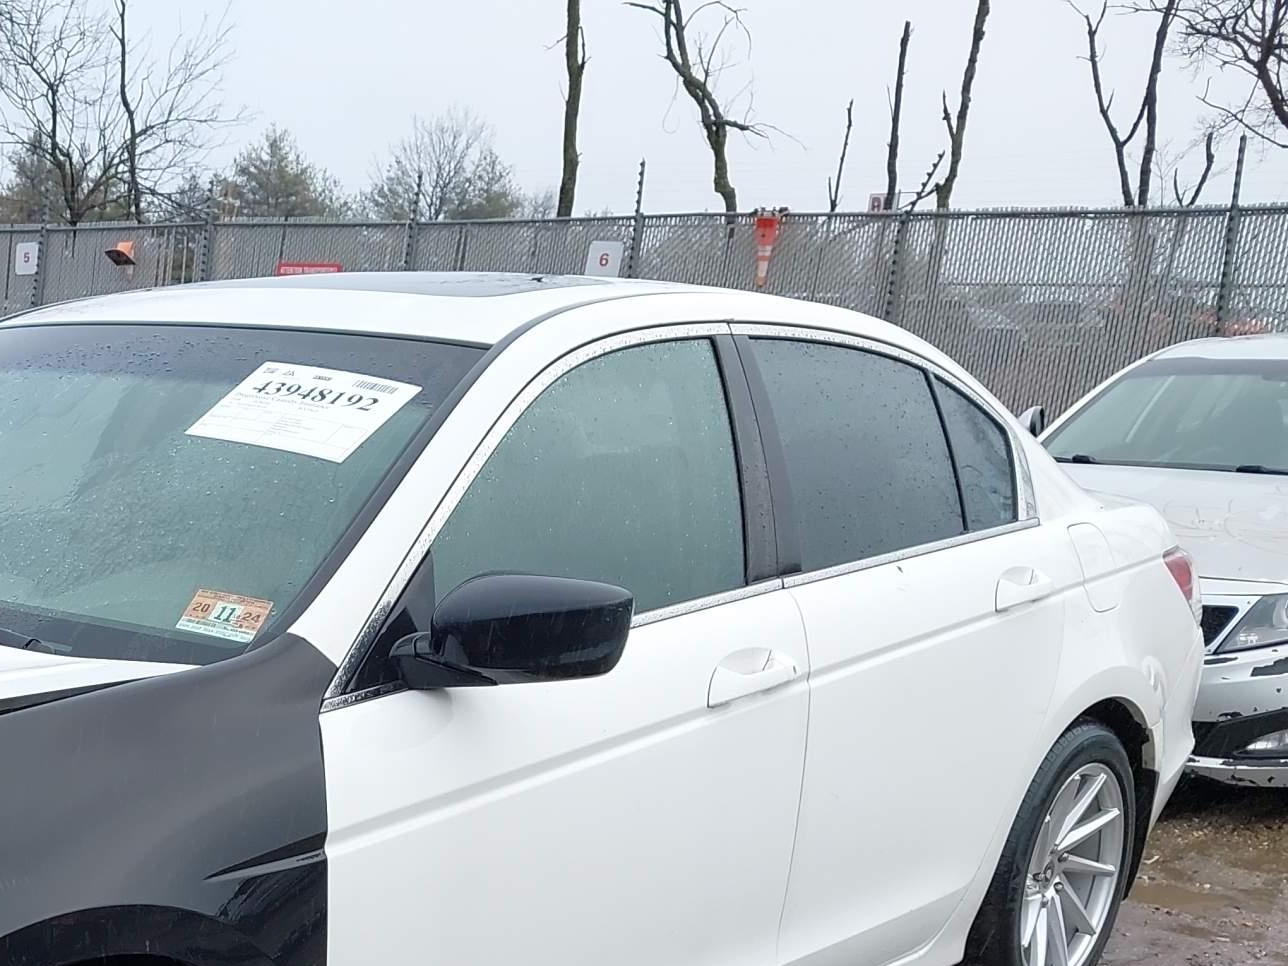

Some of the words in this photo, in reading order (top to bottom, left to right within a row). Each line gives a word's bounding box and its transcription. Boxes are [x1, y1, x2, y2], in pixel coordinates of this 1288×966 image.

[23, 252, 30, 263] 5
[599, 253, 609, 267] 6
[252, 380, 379, 411] 43948192
[192, 602, 211, 613] 20
[213, 605, 237, 623] 11
[241, 612, 261, 623] 24
